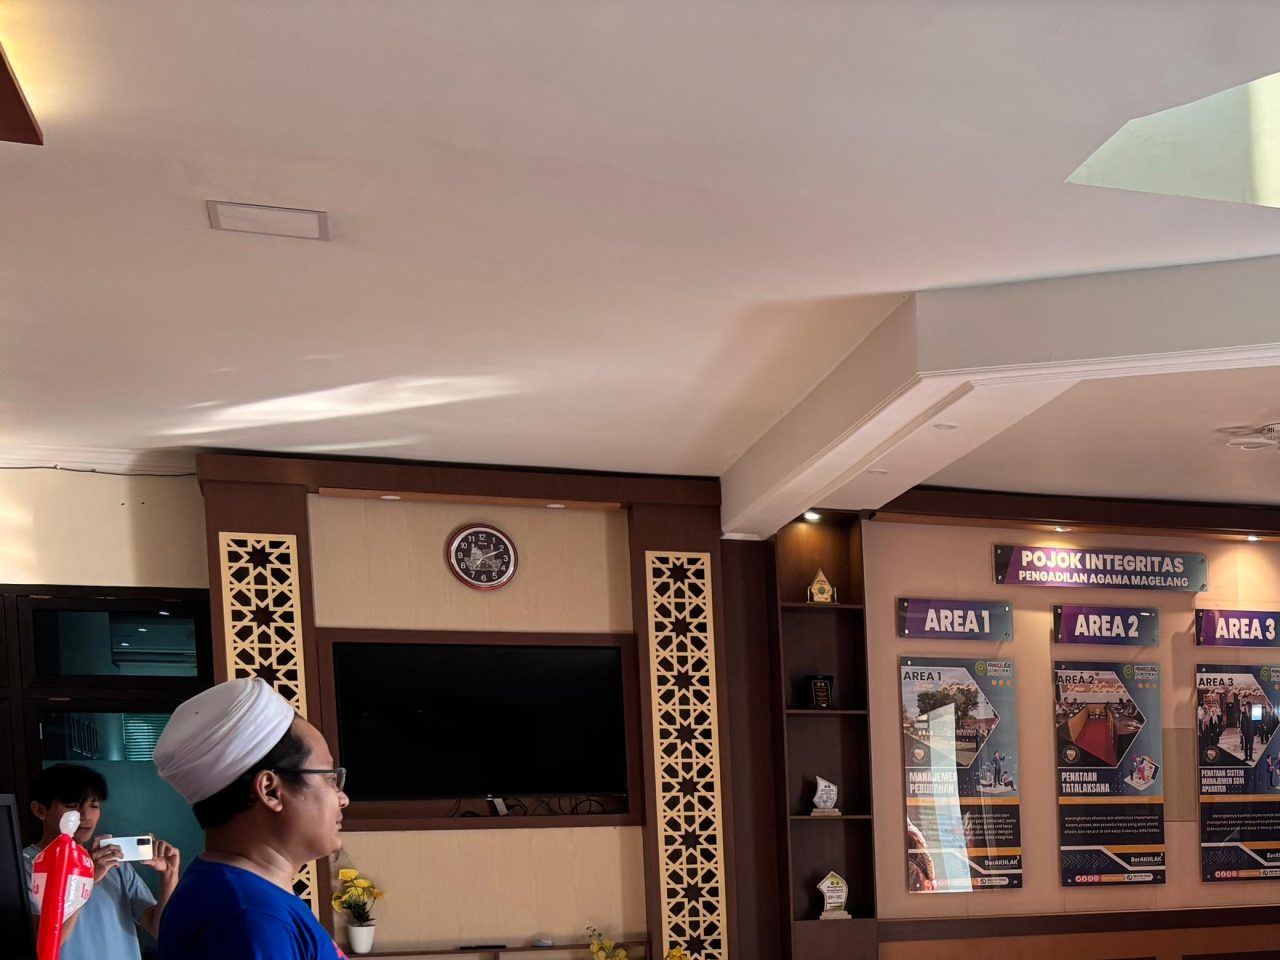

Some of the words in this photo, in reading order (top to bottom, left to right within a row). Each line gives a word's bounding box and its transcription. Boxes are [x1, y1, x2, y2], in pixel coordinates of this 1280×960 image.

[1021, 550, 1083, 569] POJOK
[1085, 553, 1184, 573] INTEGRITAS
[1018, 570, 1089, 584] PENGADILAN
[1089, 573, 1133, 585] AGAMA
[1131, 575, 1189, 587] MAGELANG
[924, 608, 980, 633] AREA
[981, 610, 990, 633] 1
[1074, 614, 1126, 637] AREA
[1127, 615, 1139, 638] 2
[1215, 617, 1264, 640] AREA
[1265, 618, 1276, 640] 3
[903, 671, 935, 681] AREA
[937, 671, 942, 681] 1
[1057, 674, 1086, 685] AREA
[1088, 675, 1095, 685] 2
[1198, 677, 1226, 687] AREA
[1228, 677, 1234, 687] 3
[1061, 771, 1097, 782] PENATAAN
[1061, 783, 1110, 794] TATALAKSANA
